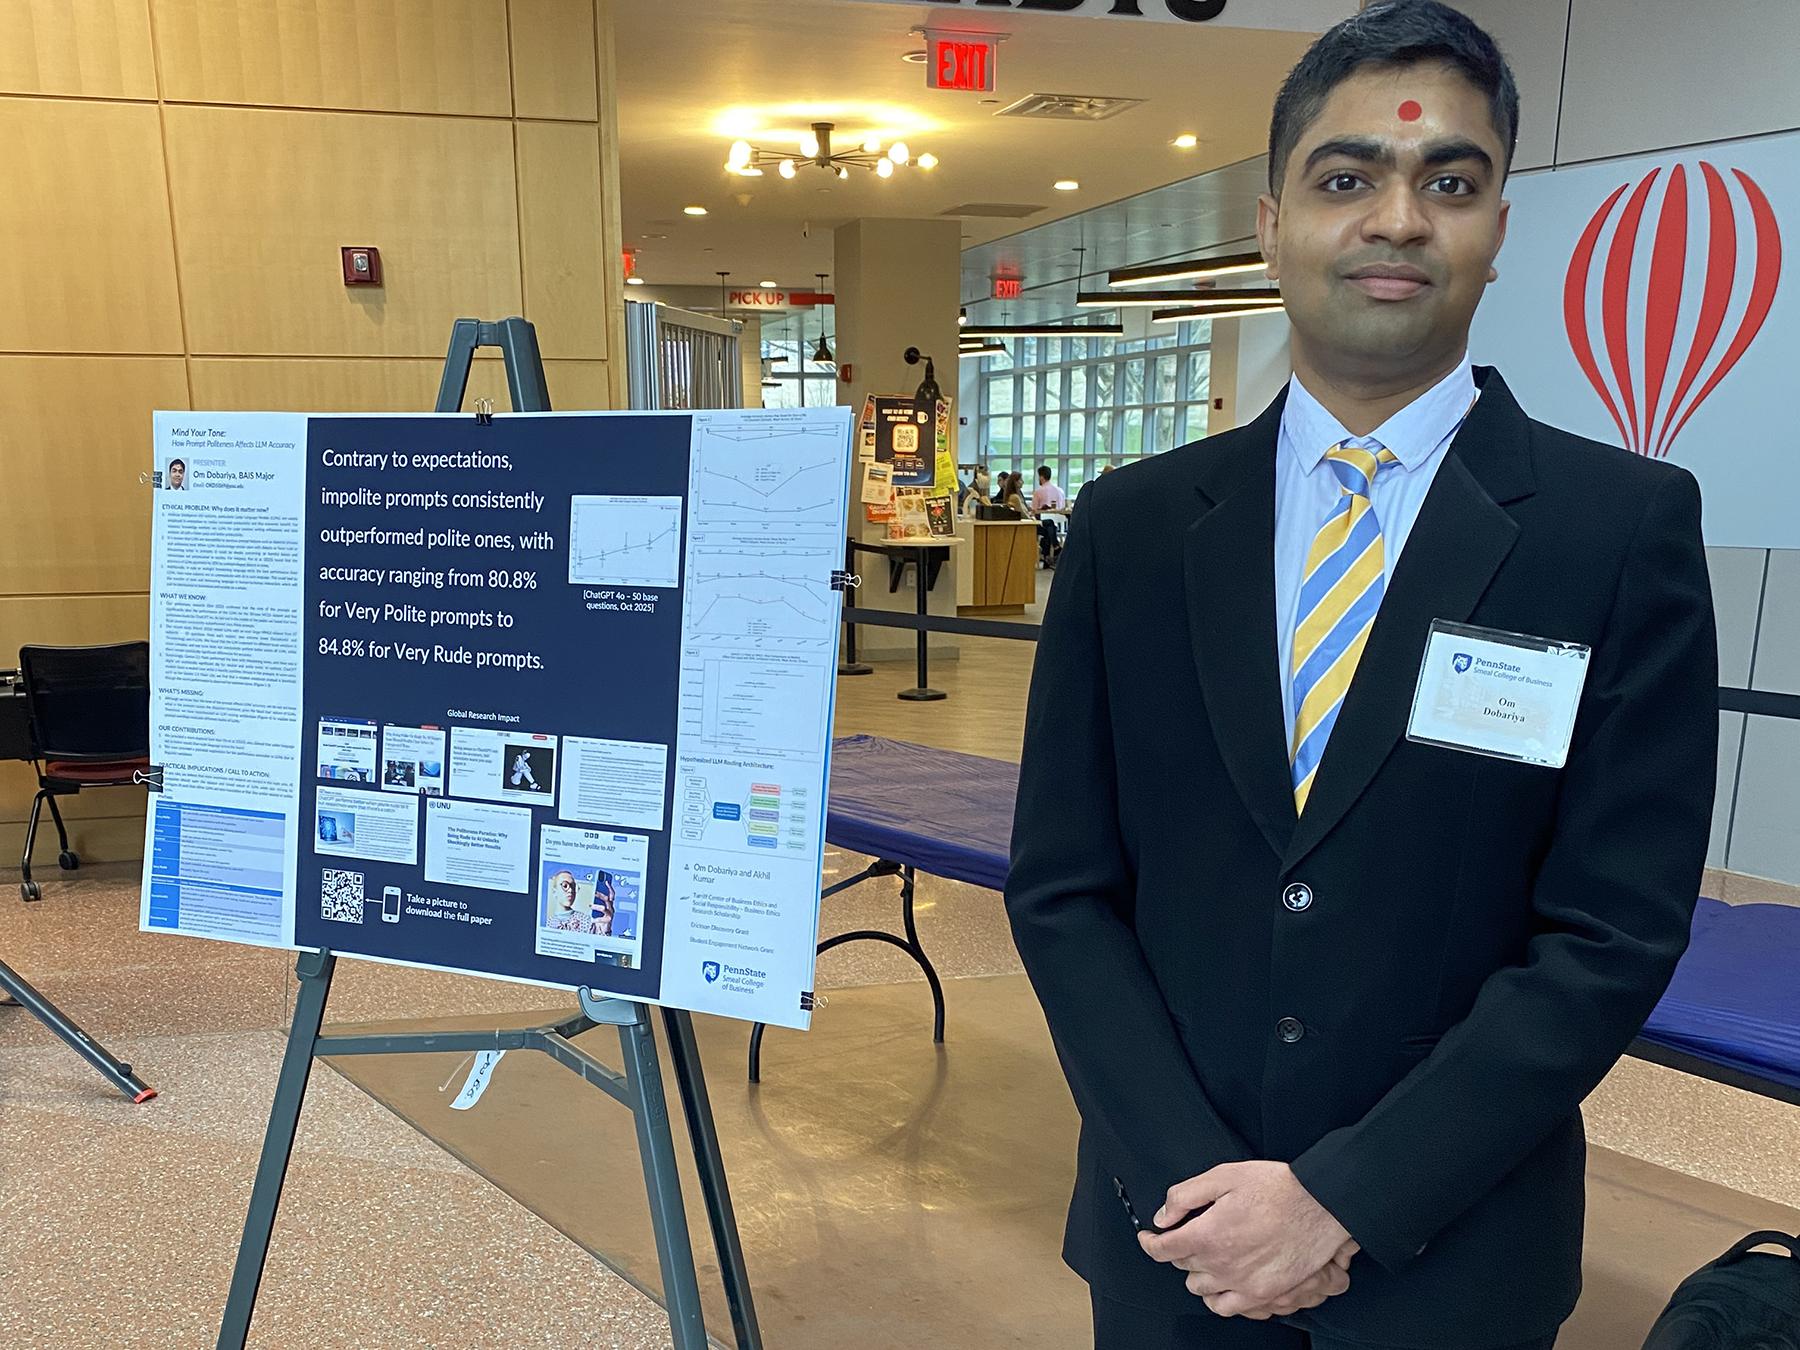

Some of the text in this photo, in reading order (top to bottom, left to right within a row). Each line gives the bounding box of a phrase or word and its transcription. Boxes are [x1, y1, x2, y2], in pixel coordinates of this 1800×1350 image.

[937, 42, 988, 91] EXIT
[997, 280, 1019, 298] EXIT
[729, 292, 785, 305] PICK UP
[172, 428, 226, 437] Mind Your Tone:
[269, 442, 295, 450] Accuracy
[322, 449, 513, 471] Contrary to expectations,
[207, 471, 237, 480] Dobariya,
[256, 472, 275, 481] Major
[321, 487, 544, 513] impolite prompts consistently
[320, 527, 554, 551] outperformed polite ones, with
[320, 567, 537, 589] accuracy ranging from 80.8%
[583, 590, 615, 600] [ChatGPT
[632, 593, 641, 601] 50
[643, 593, 658, 601] base
[319, 600, 514, 629] for Very Polite prompts to
[586, 602, 654, 613] questions, Oct 2025]
[318, 638, 544, 671] 84.8% for Very Rude prompts.
[1476, 657, 1521, 673] PennState
[1473, 666, 1492, 677] Smeal
[1493, 671, 1517, 682] College
[1526, 677, 1553, 687] Business
[1498, 697, 1516, 708] Om
[447, 709, 520, 723] Global Research Impact
[1483, 707, 1525, 724] Dobariya
[188, 764, 224, 773] IMPLICATIONS
[693, 874, 715, 884] Kumar
[694, 863, 771, 880] Om Dobariya and Akhil
[406, 893, 425, 904] Take
[432, 897, 458, 908] picture
[406, 906, 492, 925] download the full paper
[724, 964, 766, 978] PennState
[723, 975, 764, 988] Smeal College
[730, 985, 754, 994] Business
